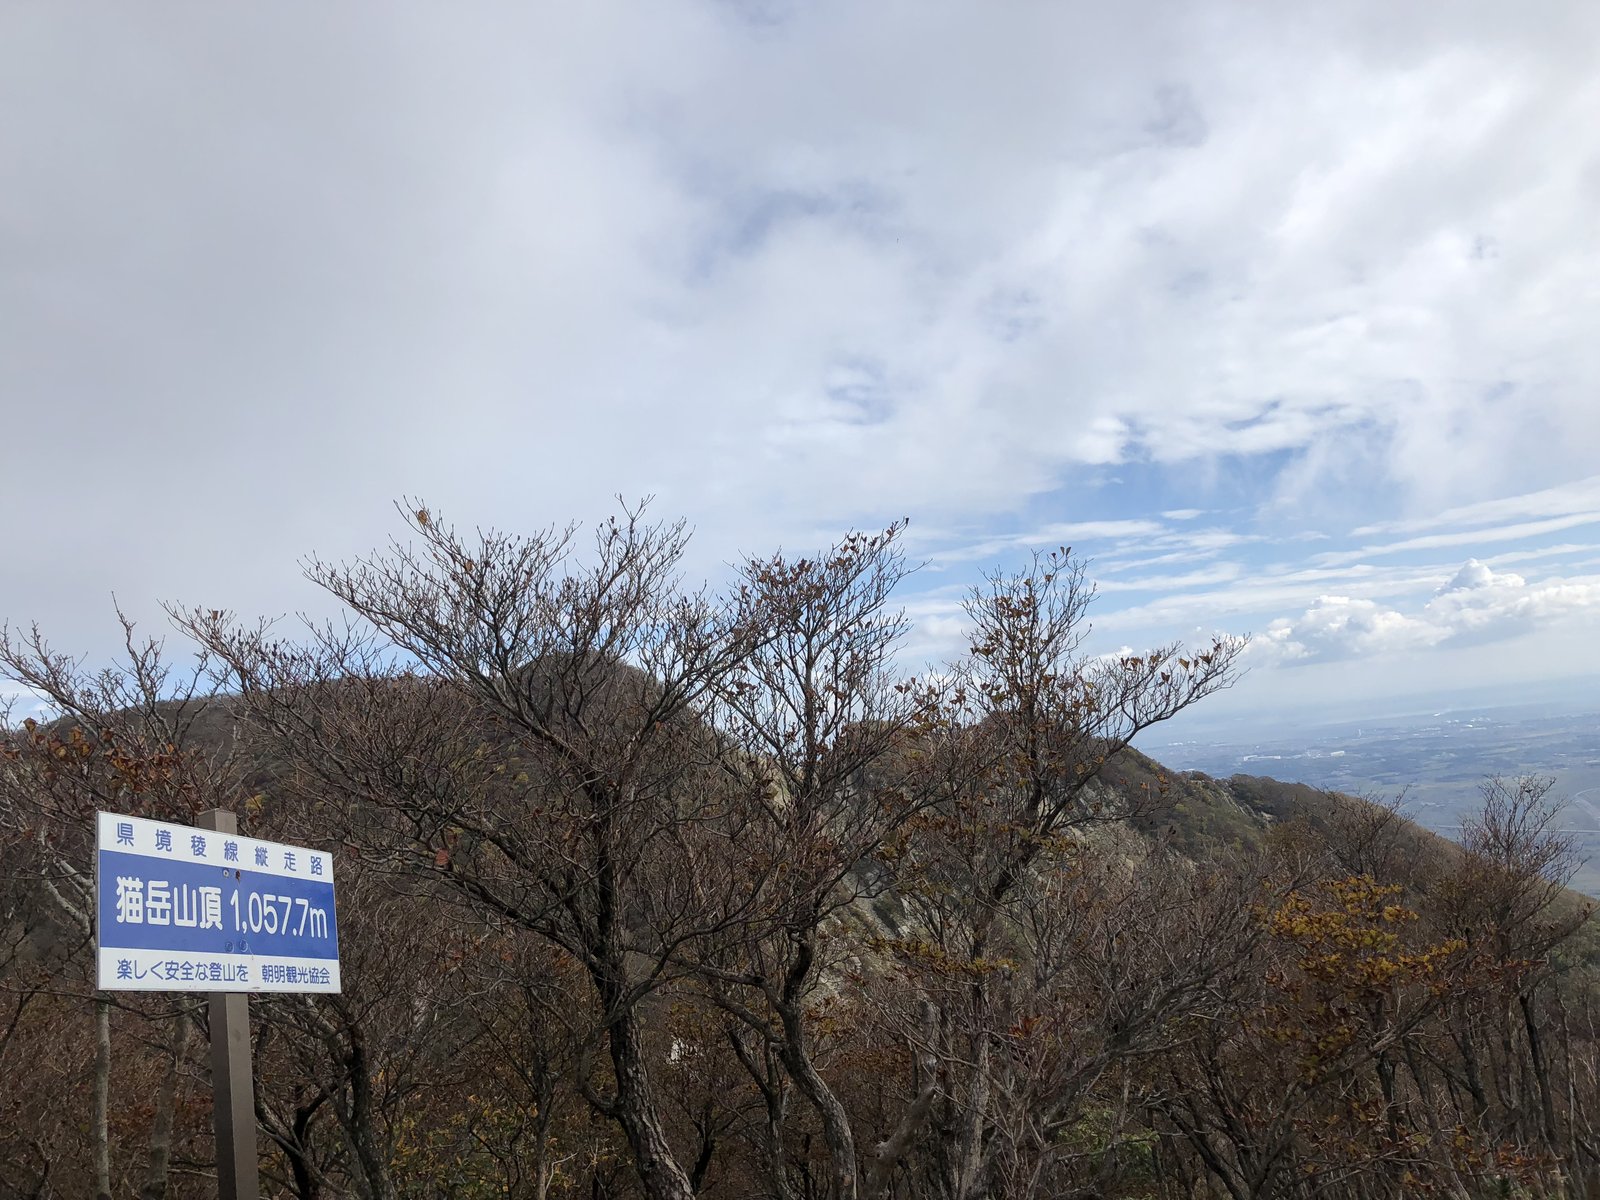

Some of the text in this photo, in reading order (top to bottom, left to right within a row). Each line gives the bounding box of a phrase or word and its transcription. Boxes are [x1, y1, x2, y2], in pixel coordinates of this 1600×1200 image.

[116, 876, 328, 939] 猫岳山頂 1,057.7m
[116, 958, 331, 985] 楽しく安全な登山を 朝明観光協会
